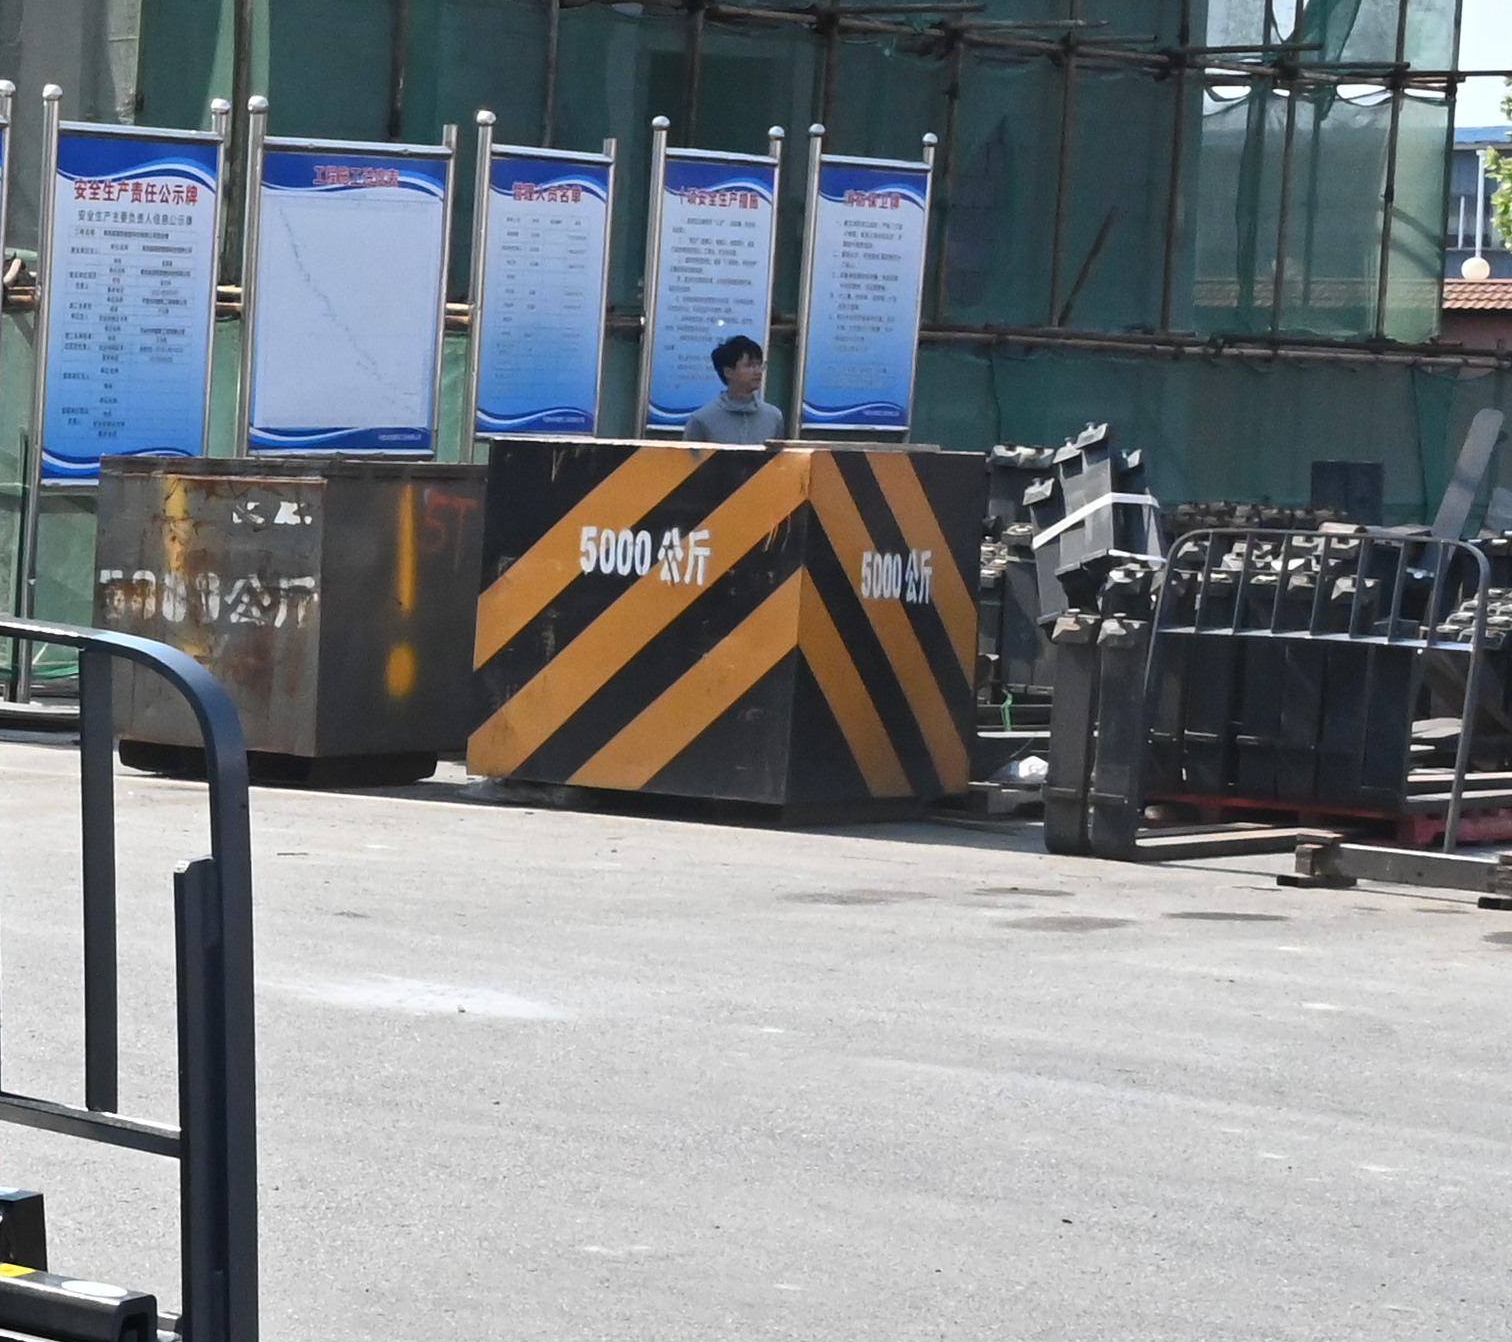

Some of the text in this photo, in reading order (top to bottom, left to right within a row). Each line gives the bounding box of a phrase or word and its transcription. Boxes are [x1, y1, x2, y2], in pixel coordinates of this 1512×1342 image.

[73, 178, 199, 207] 安全生产责任公示牌
